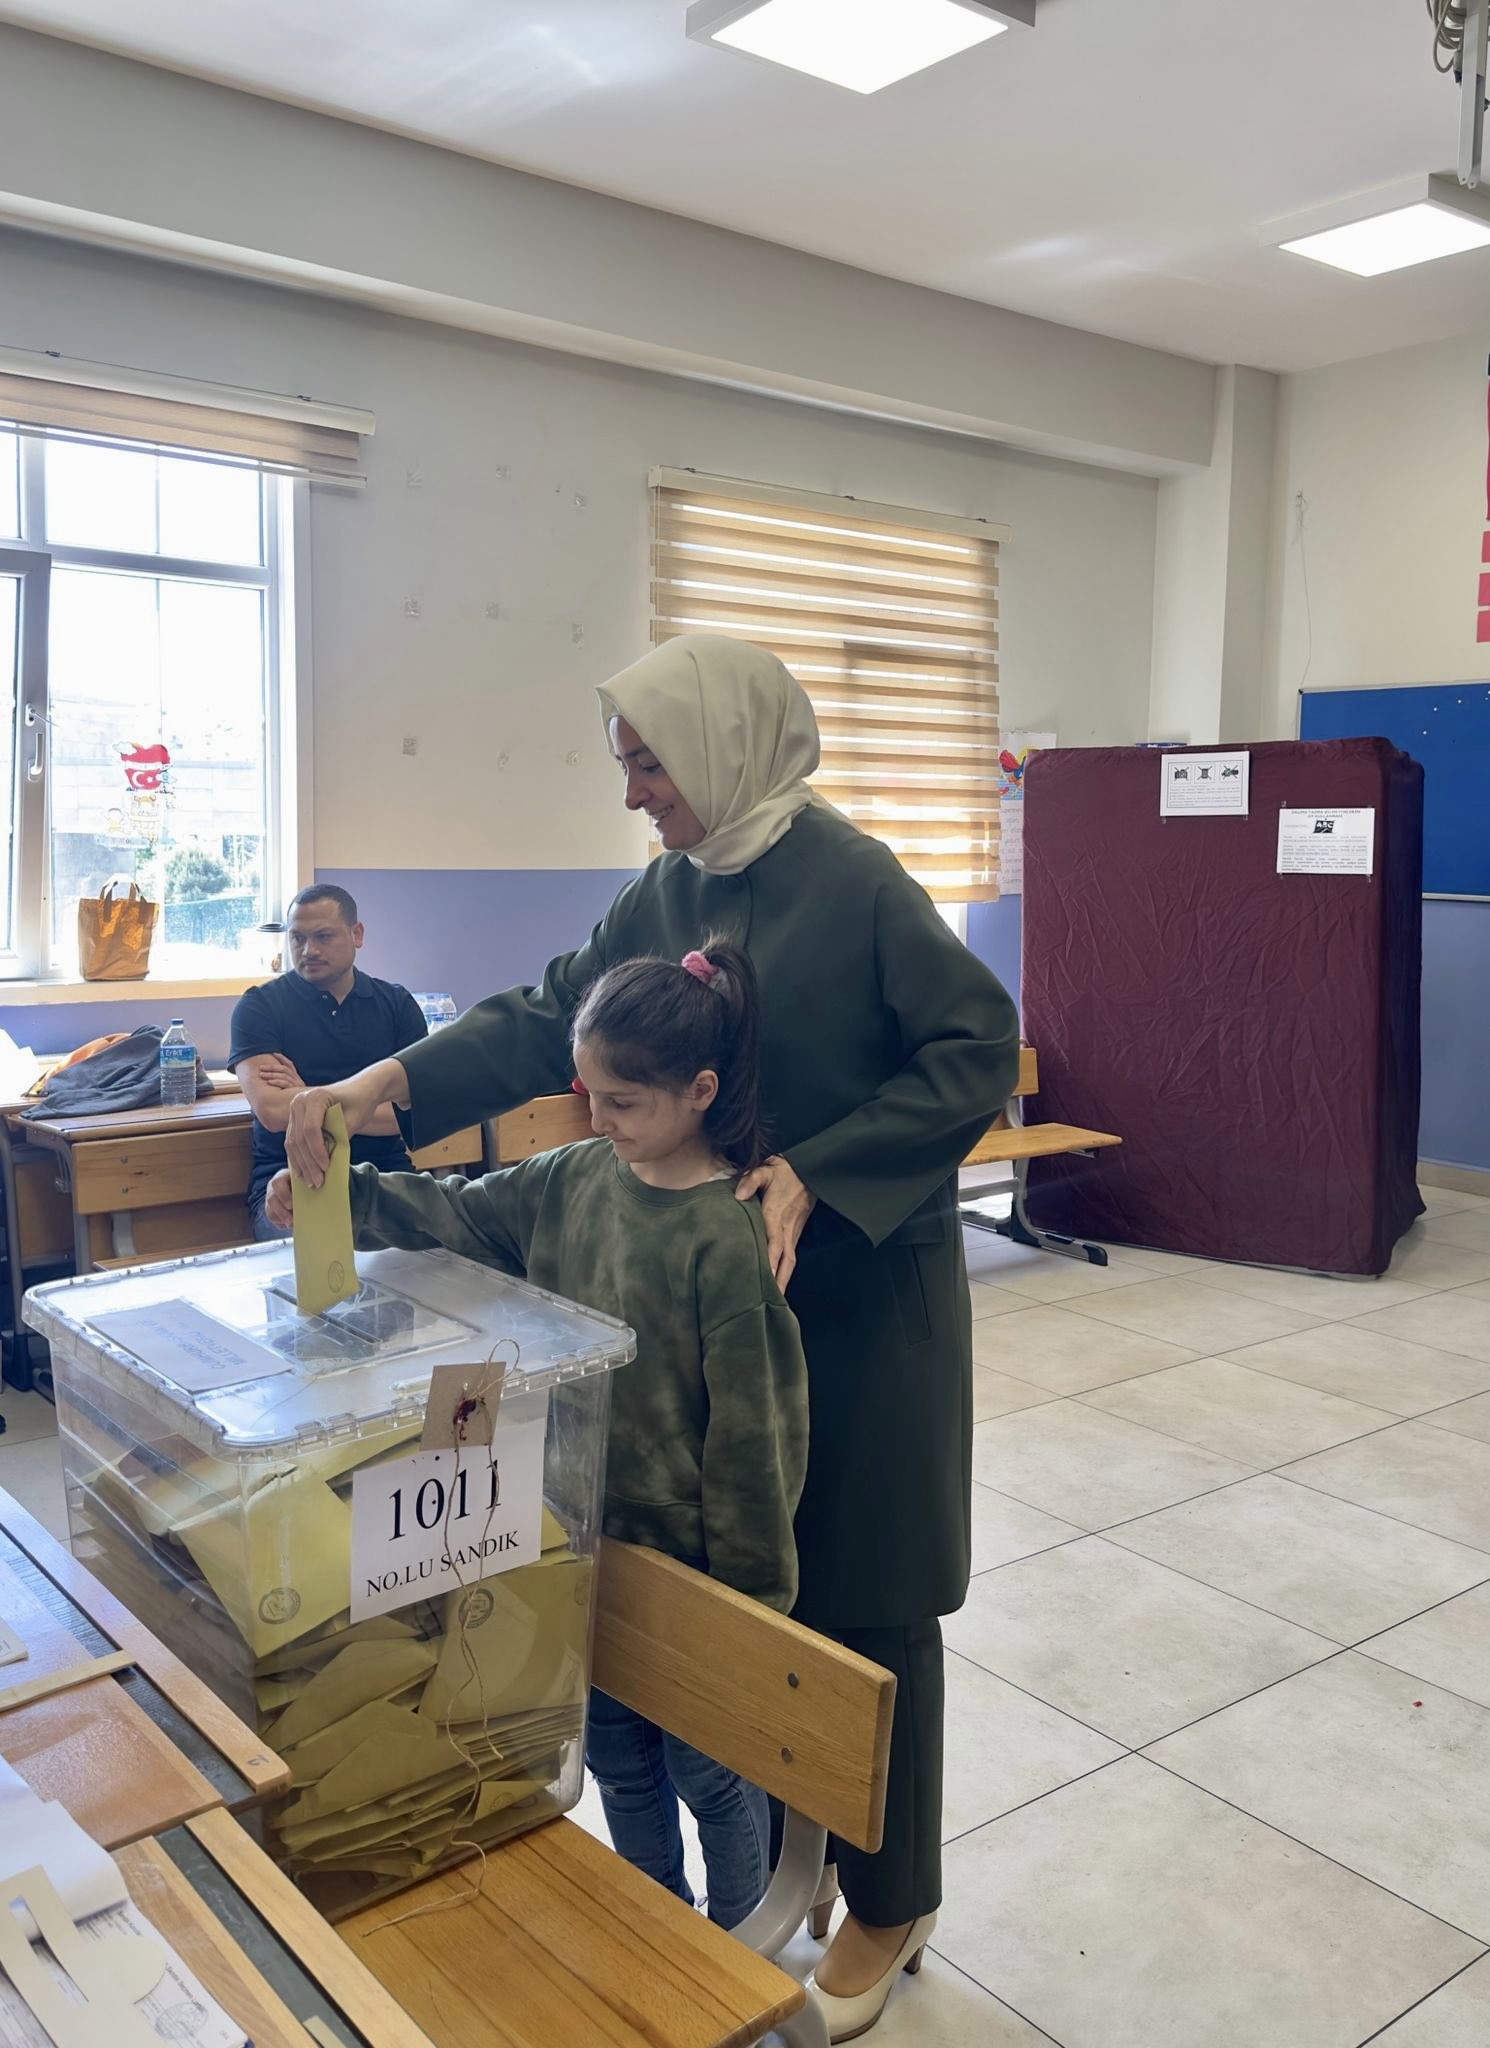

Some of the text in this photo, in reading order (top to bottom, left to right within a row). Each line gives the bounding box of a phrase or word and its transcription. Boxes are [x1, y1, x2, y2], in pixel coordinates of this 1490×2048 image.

[388, 1460, 502, 1542] 1011
[366, 1530, 520, 1597] NO.LU SANDIK
